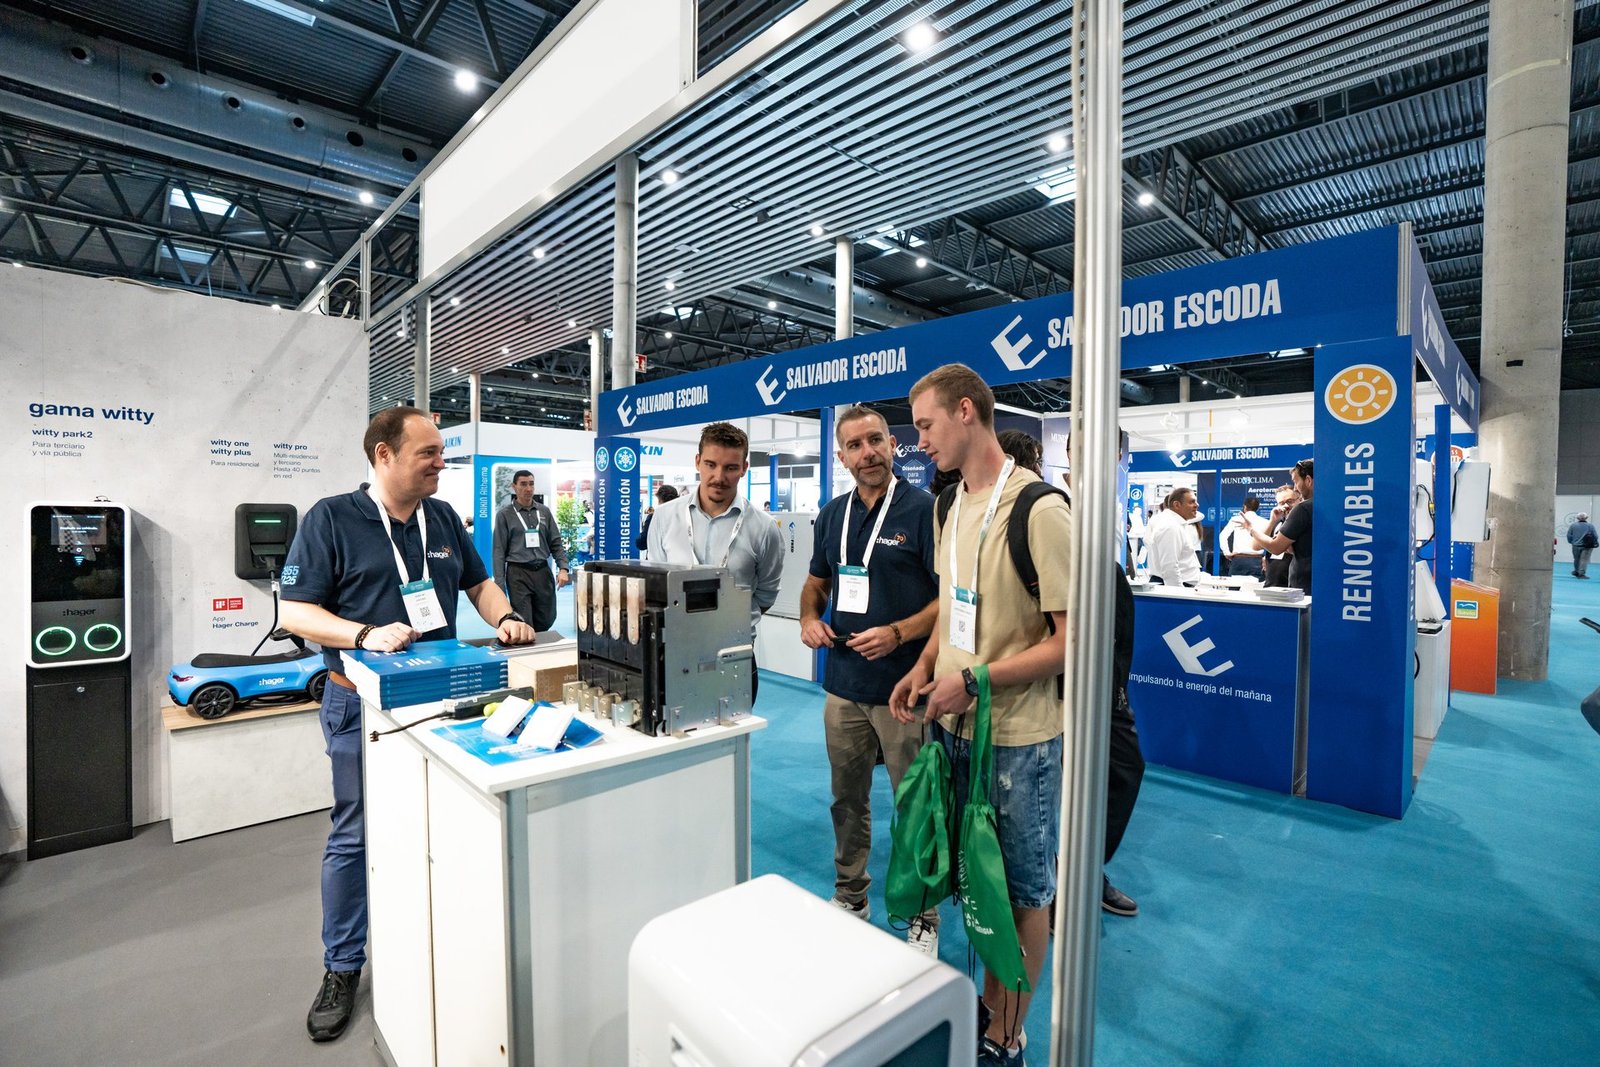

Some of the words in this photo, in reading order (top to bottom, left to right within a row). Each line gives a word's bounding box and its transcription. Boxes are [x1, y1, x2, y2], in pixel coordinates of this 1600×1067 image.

[1048, 300, 1164, 349] SADOR
[1173, 278, 1282, 330] ESCODA
[786, 358, 848, 390] SALVADOR
[852, 346, 907, 379] ESCODA
[636, 391, 674, 415] SALVADOR
[676, 384, 709, 408] ESCODA
[29, 403, 94, 417] gama
[102, 407, 154, 425] witty
[32, 429, 59, 438] witty
[210, 439, 232, 447] witty
[445, 436, 462, 447] AIKIN
[54, 442, 85, 450] terciario
[210, 448, 232, 456] witty
[640, 446, 663, 456] KIN
[1191, 449, 1233, 461] SALVADOR
[1236, 447, 1269, 459] ESCODA
[597, 478, 606, 560] EFRIGERACIÓN
[618, 478, 630, 560] EFRIGERACIÓN
[1342, 442, 1375, 622] RENOVABLES
[1176, 679, 1183, 689] la
[1186, 682, 1216, 695] energía
[1219, 686, 1232, 696] del
[1235, 689, 1272, 702] mañana
